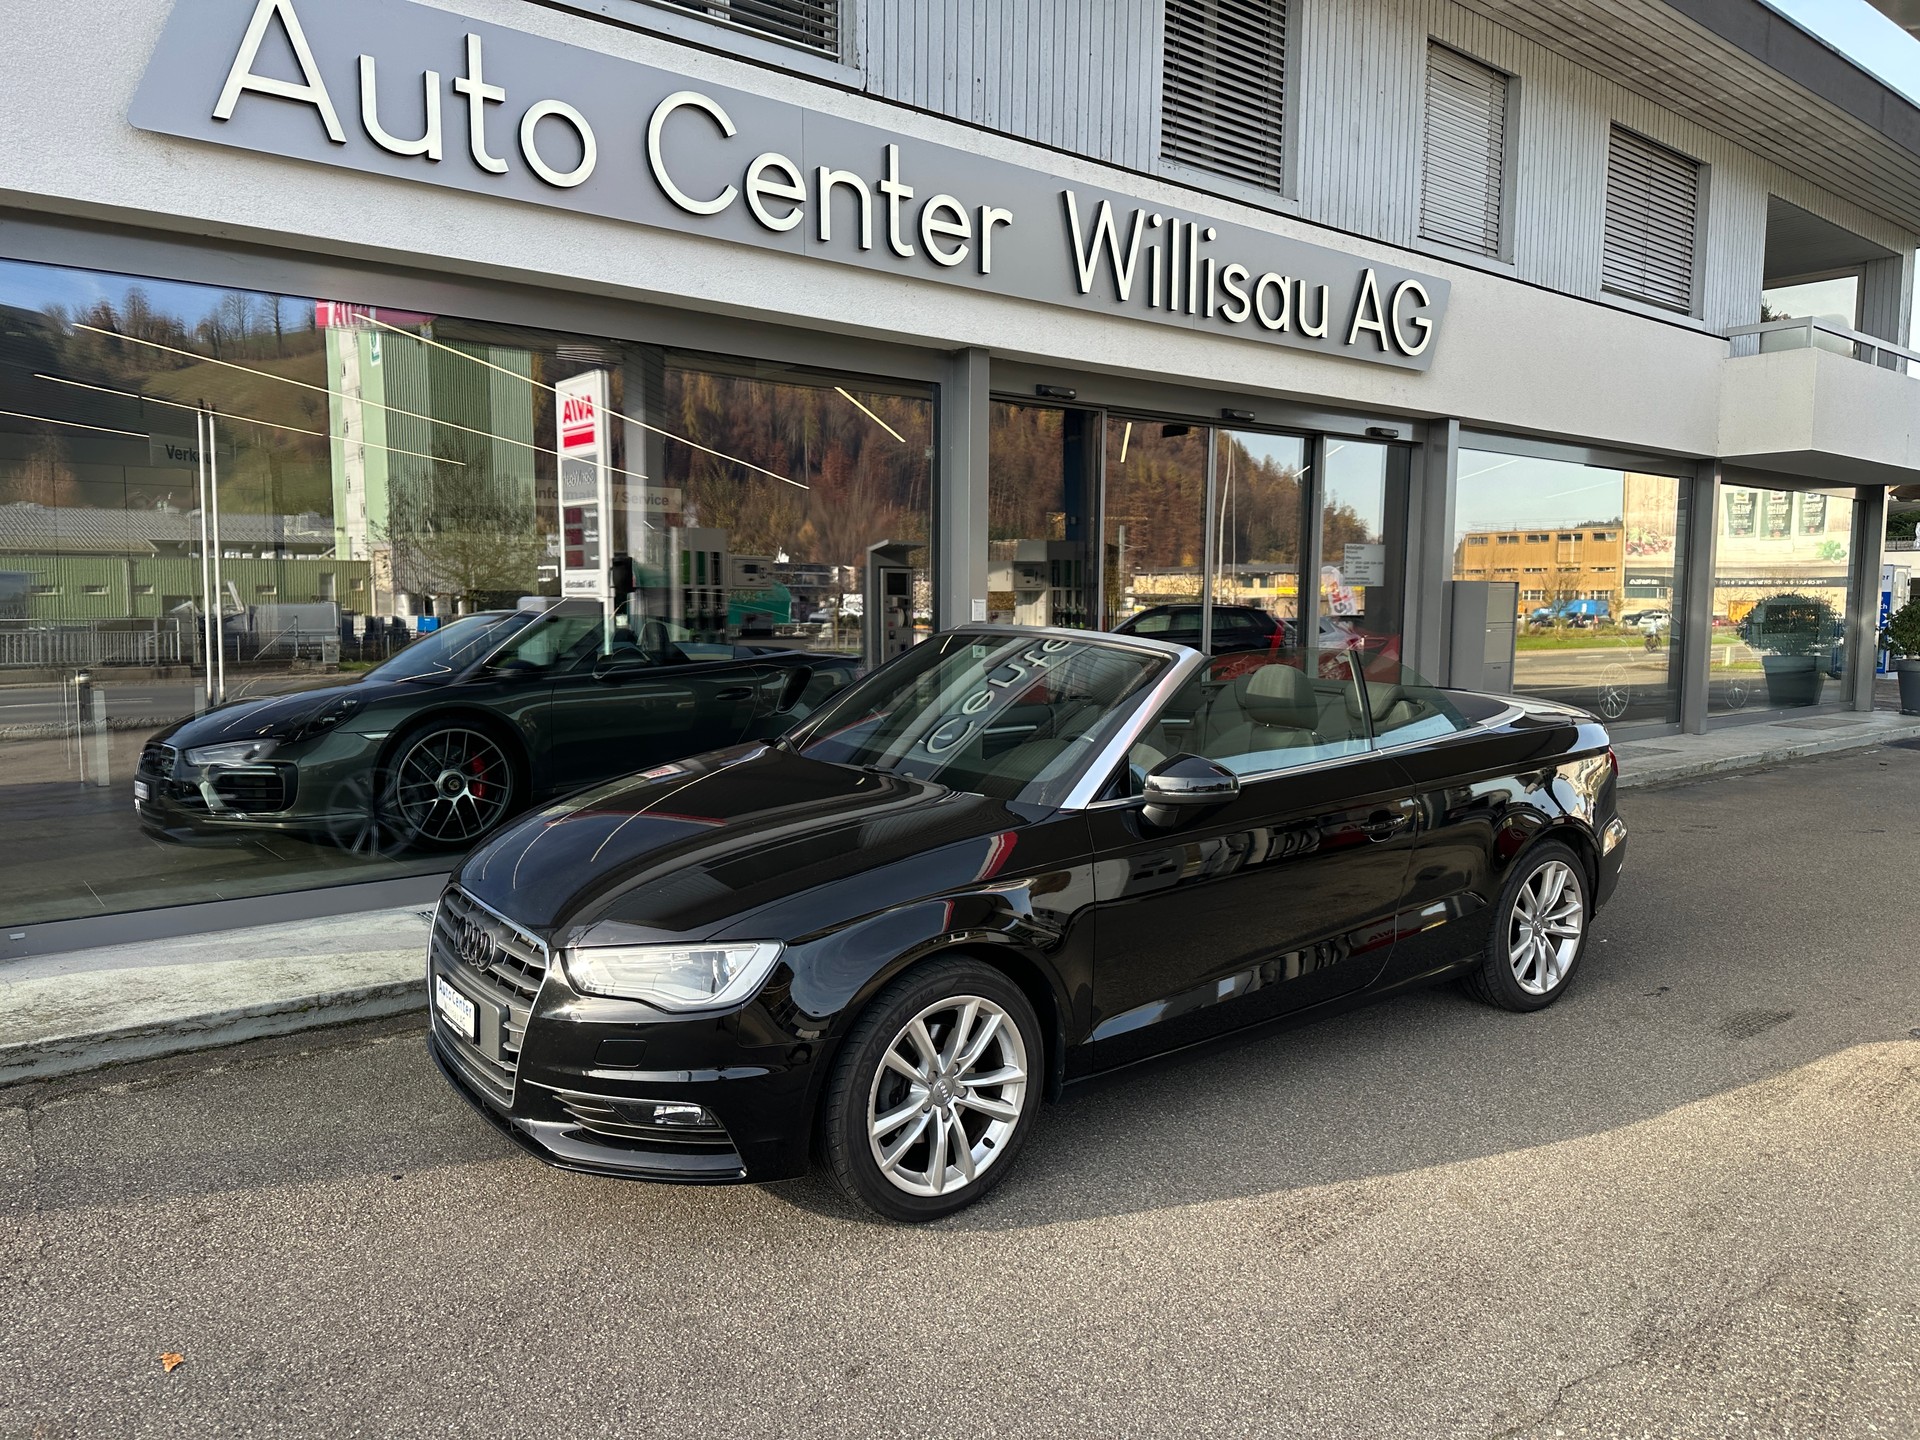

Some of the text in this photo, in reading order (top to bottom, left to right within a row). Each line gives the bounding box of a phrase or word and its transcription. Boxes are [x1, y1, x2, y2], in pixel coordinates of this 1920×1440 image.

[211, 0, 1434, 358] Auto Center Willisau AG
[165, 443, 219, 465] Verku
[622, 491, 669, 506] Service
